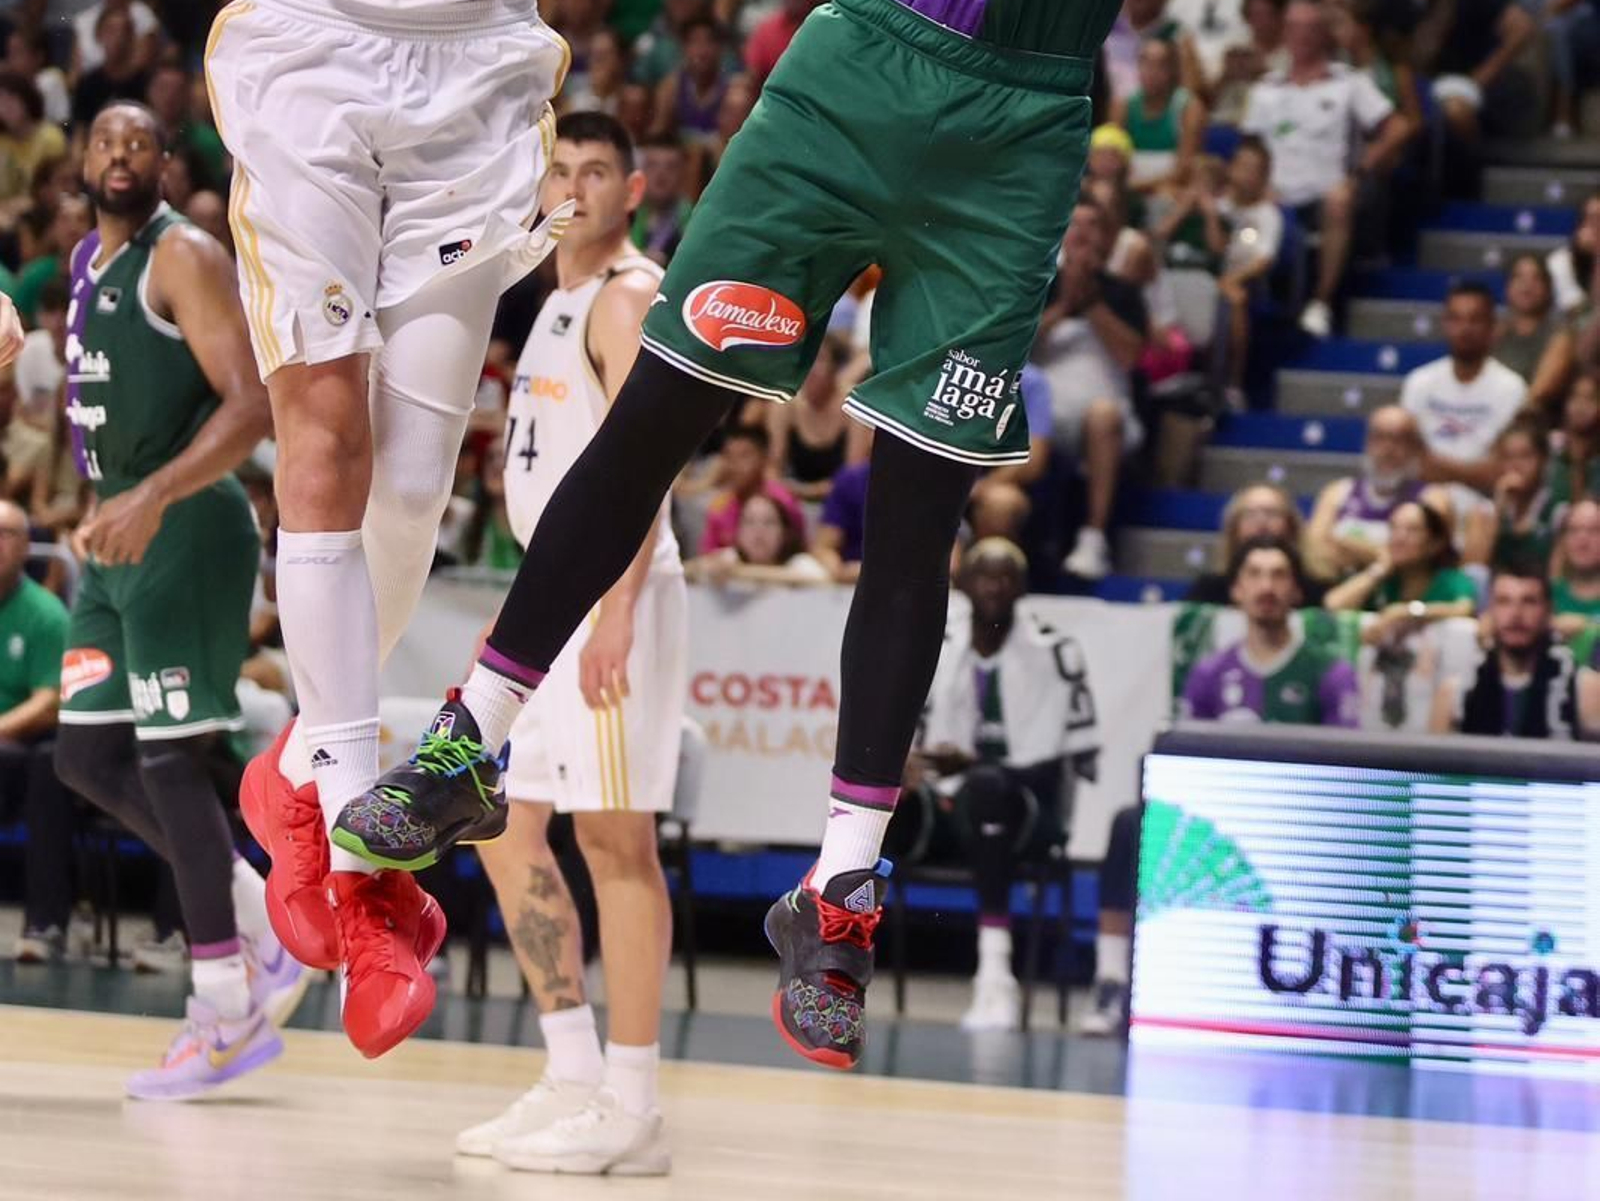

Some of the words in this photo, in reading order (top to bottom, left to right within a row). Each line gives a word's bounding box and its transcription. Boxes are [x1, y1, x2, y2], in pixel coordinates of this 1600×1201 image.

[943, 359, 953, 371] a
[948, 349, 981, 367] sabor
[932, 372, 996, 419] laga
[689, 672, 837, 708] COSTA
[1258, 920, 1600, 1035] Unicaja
